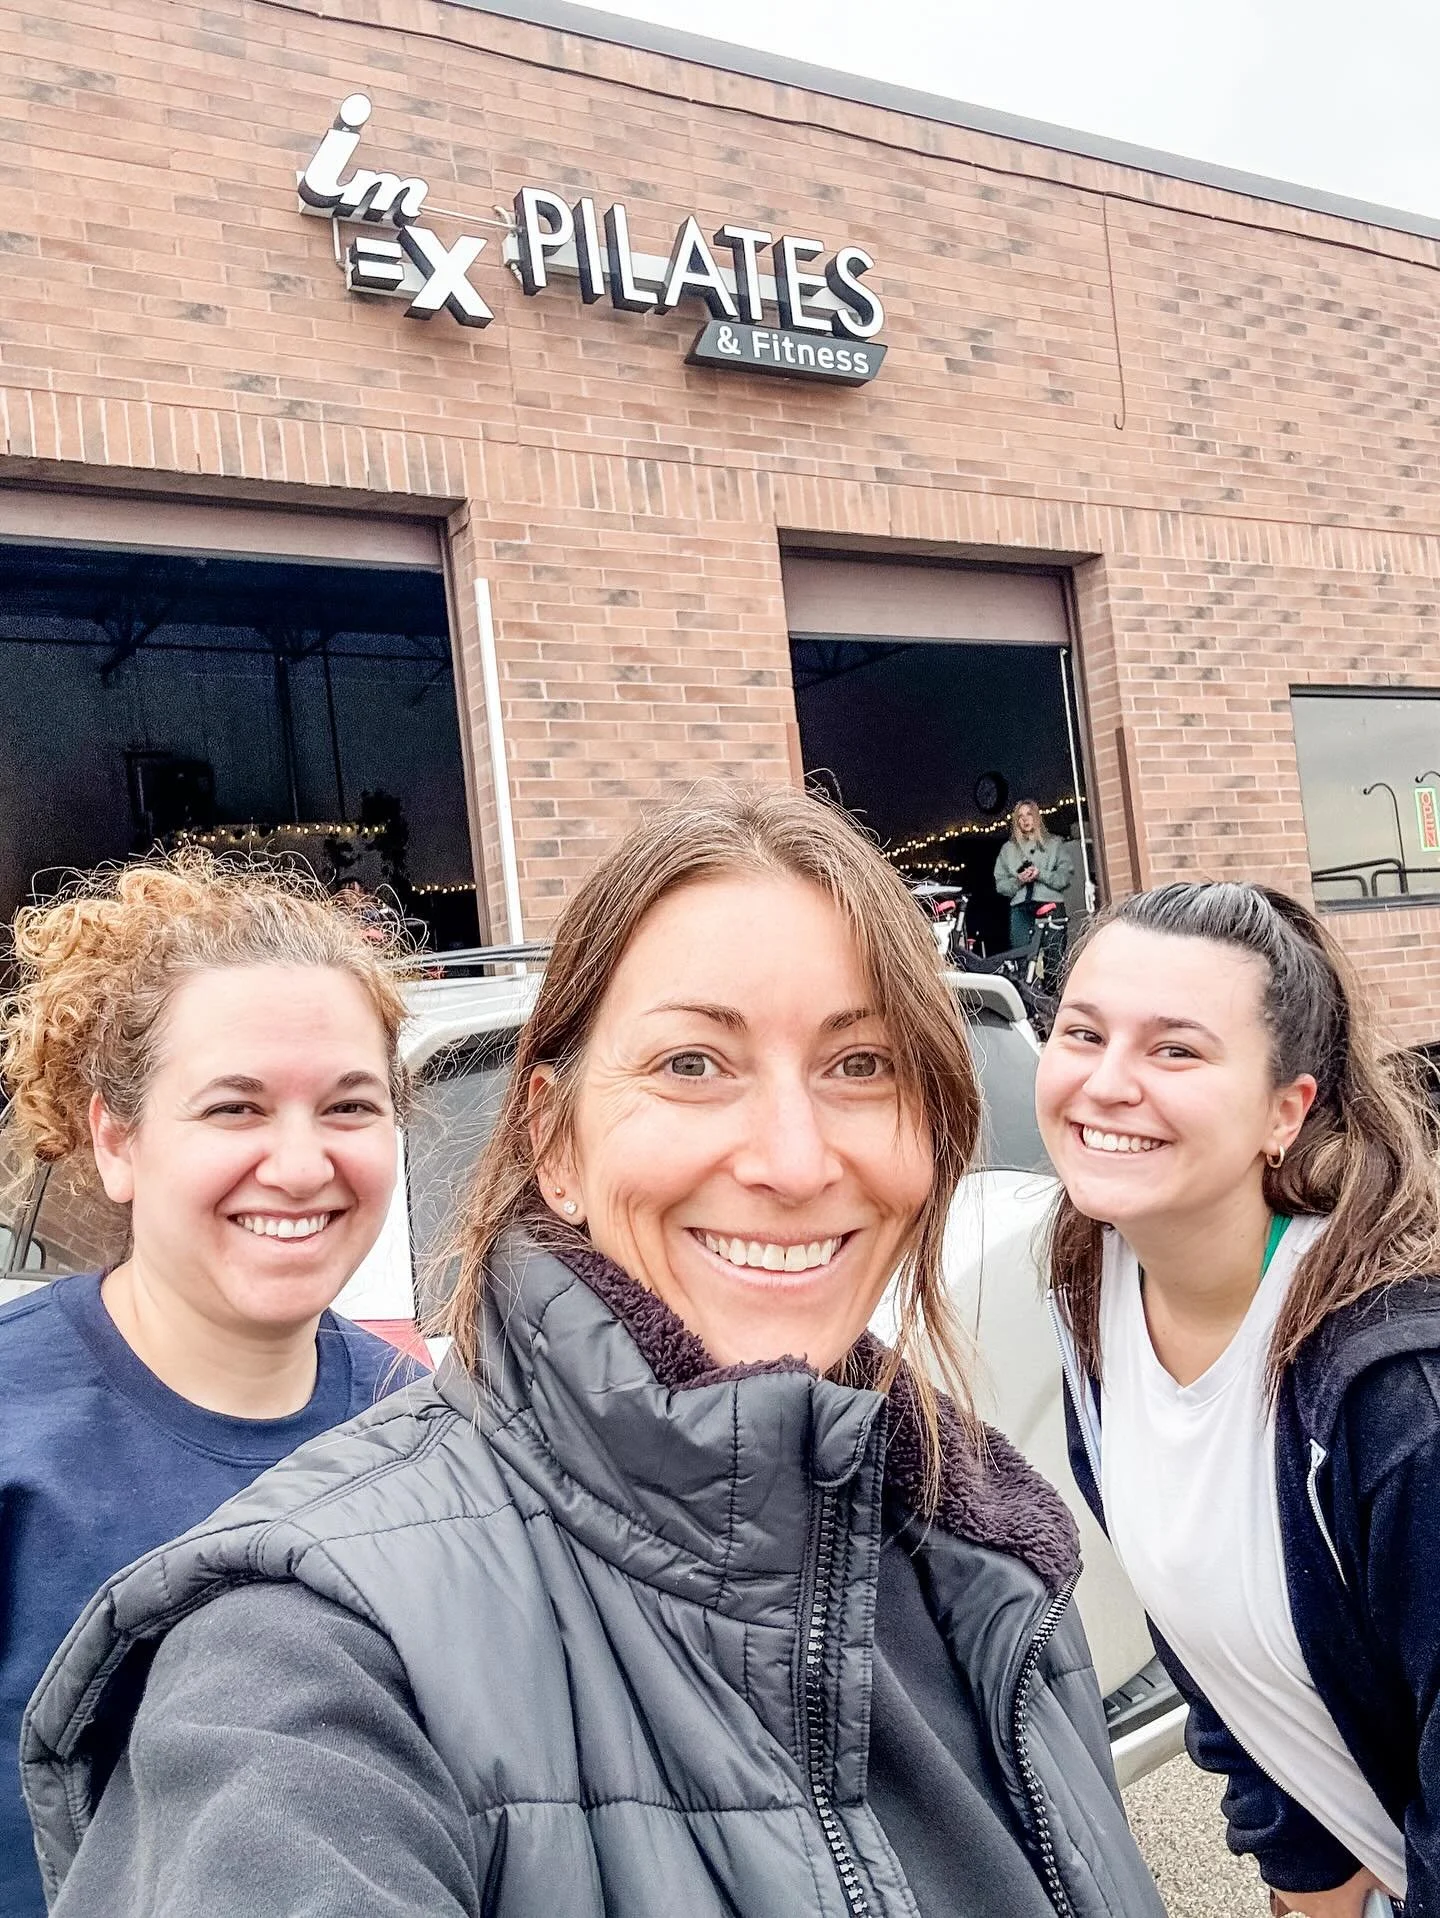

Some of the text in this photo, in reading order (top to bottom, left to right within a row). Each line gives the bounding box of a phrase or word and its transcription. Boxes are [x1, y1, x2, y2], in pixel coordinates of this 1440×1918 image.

[303, 93, 430, 217] im
[518, 187, 884, 339] PILATES
[716, 325, 870, 374] & Fitness
[1421, 792, 1437, 848] OPEN
